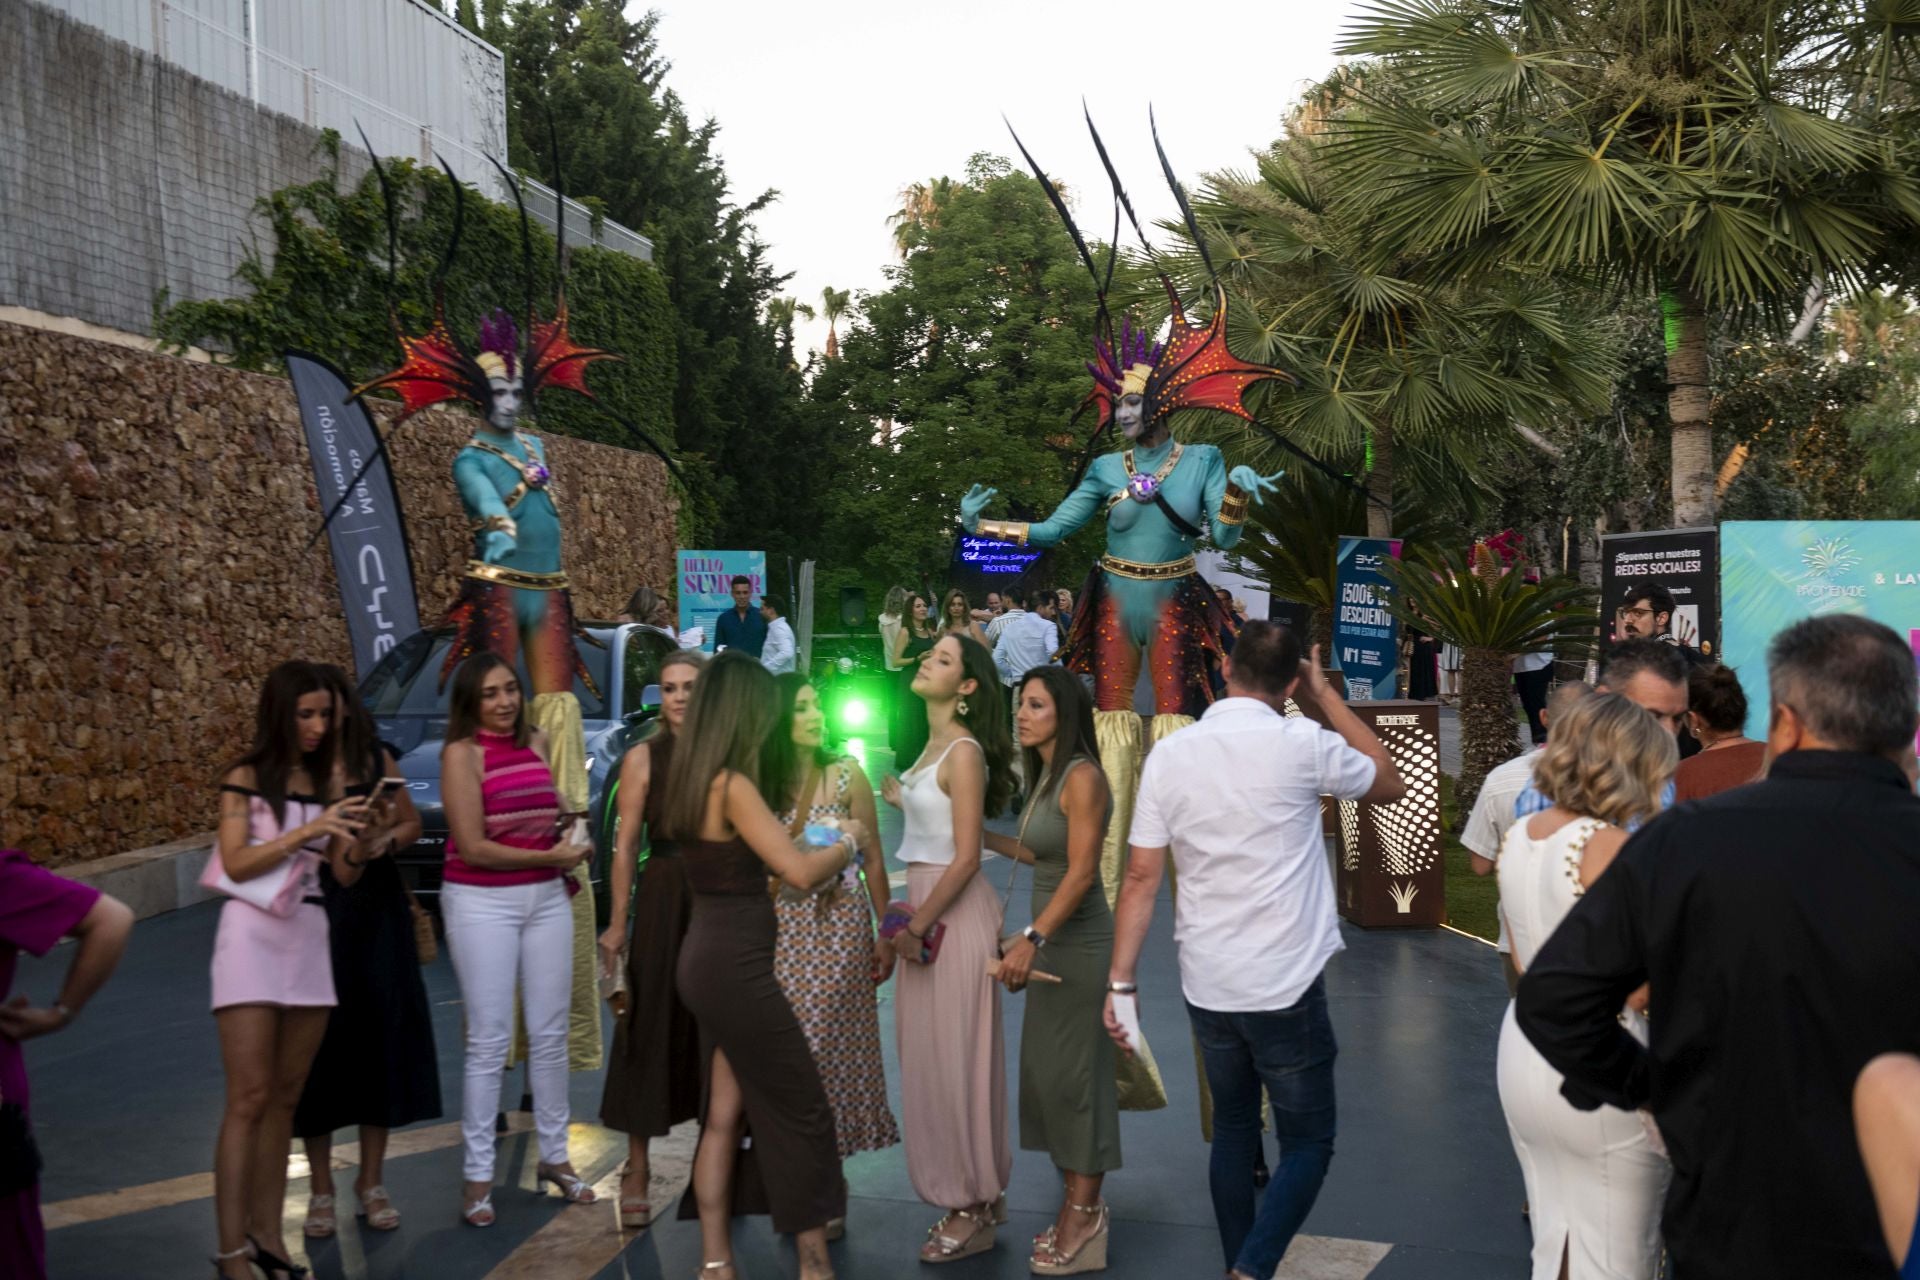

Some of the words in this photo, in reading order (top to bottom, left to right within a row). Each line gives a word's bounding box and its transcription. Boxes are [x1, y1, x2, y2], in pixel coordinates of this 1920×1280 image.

[1655, 552, 1665, 560] en
[1666, 548, 1701, 559] nuestras
[684, 558, 724, 573] HELLO
[1615, 563, 1649, 577] REDES
[1650, 560, 1702, 575] SOCIALES!
[684, 574, 762, 595] SUMR
[1874, 573, 1886, 585] &
[1340, 605, 1392, 627] DESCUENTO
